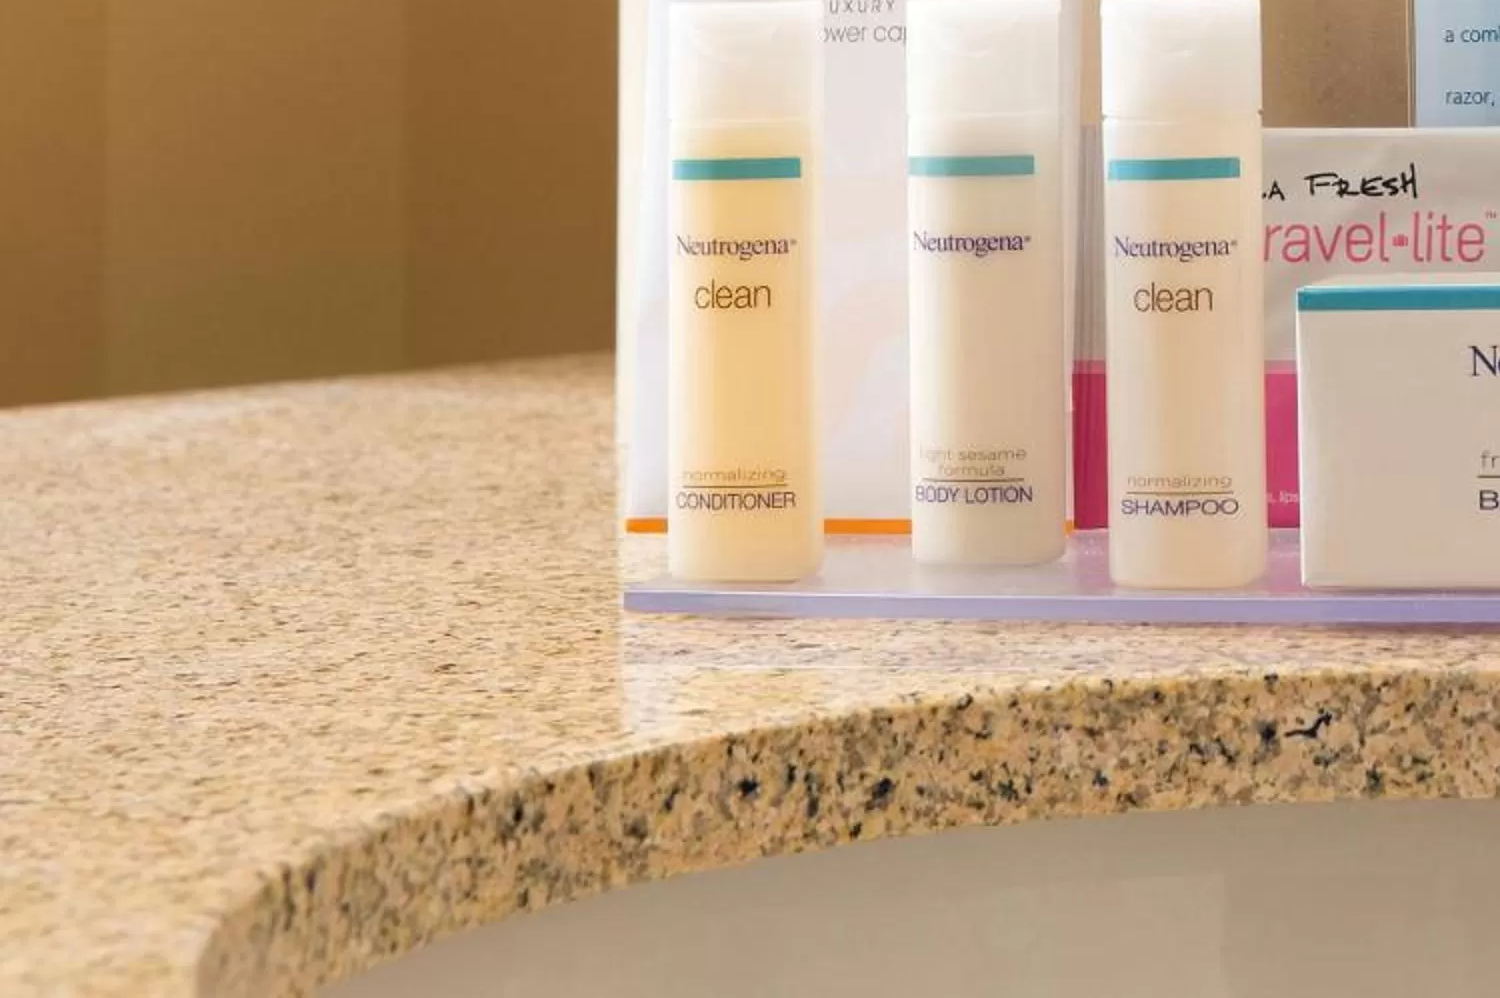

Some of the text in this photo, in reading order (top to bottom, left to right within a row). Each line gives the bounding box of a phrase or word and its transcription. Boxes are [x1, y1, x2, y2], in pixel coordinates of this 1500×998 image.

[873, 25, 907, 47] ca
[1444, 28, 1455, 43] a
[1445, 90, 1495, 107] razor,
[1303, 162, 1418, 199] FRESH
[695, 278, 772, 309] clean
[1133, 282, 1214, 313] clean
[958, 448, 1028, 461] sesame
[682, 467, 788, 484] normalizing
[938, 463, 1006, 476] formula
[1127, 475, 1233, 489] normalizing
[675, 490, 797, 511] CONDITIONER
[915, 485, 1033, 505] BODY LOTION
[1121, 498, 1240, 517] SHAMPOO
